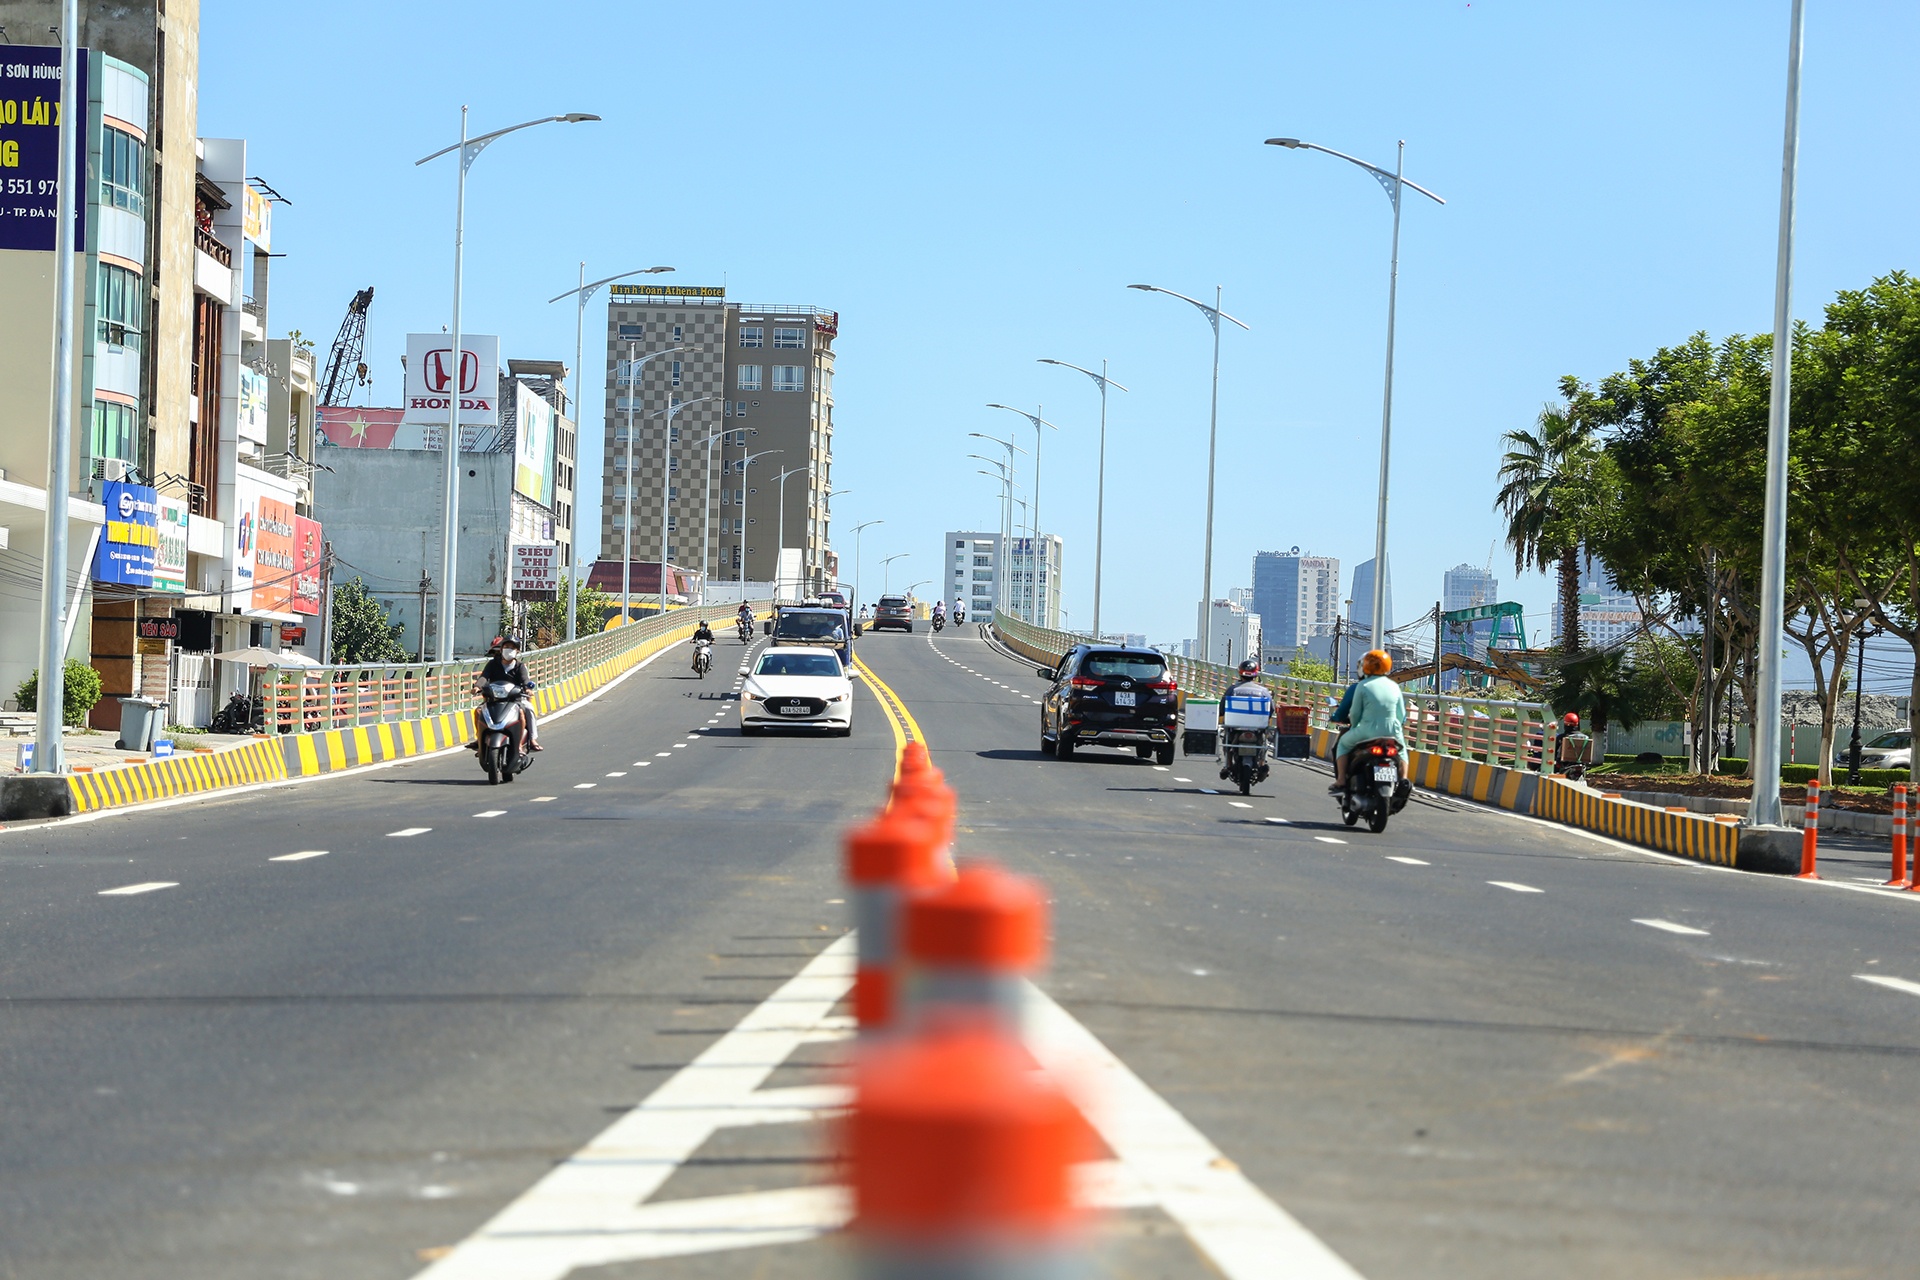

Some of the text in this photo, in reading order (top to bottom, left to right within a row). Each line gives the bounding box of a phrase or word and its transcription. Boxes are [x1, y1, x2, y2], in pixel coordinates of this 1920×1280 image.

[6, 63, 29, 78] SƠN
[33, 62, 62, 79] HÙNG
[22, 96, 49, 126] LÁI
[8, 179, 33, 194] 551
[13, 208, 27, 217] TP.
[30, 206, 45, 217] ĐÀ
[610, 284, 725, 297] Minh Toan Athena Hotel
[517, 546, 553, 557] SIÊU
[521, 557, 549, 568] THỊ
[1301, 560, 1325, 569] VANDA
[522, 567, 548, 578] NỘI
[513, 577, 556, 589] THẤT
[140, 619, 177, 638] YẾN SÀO
